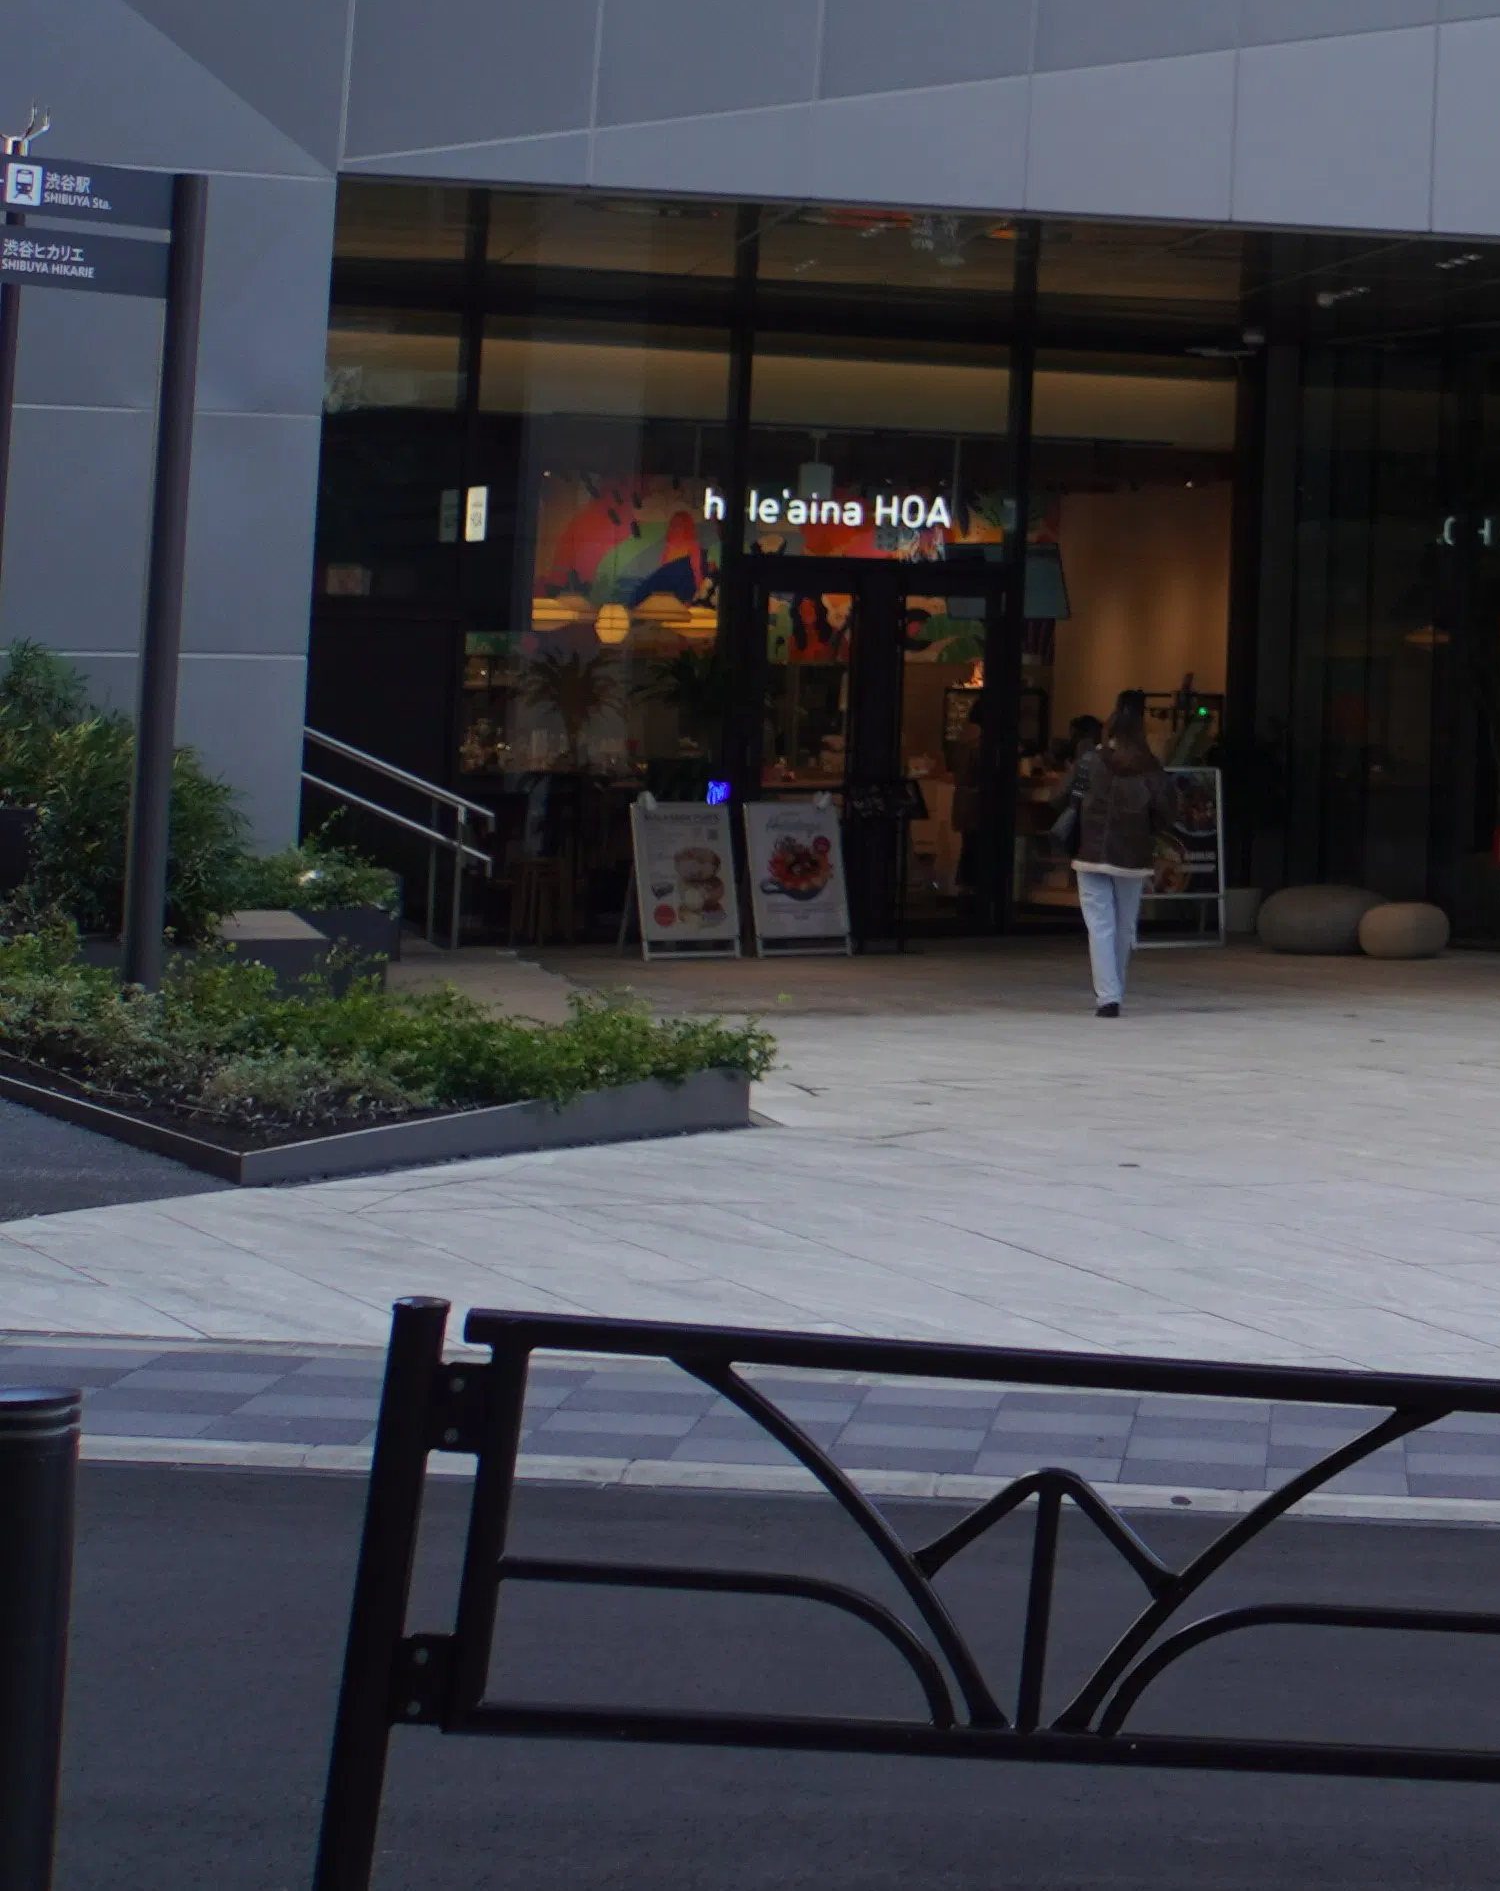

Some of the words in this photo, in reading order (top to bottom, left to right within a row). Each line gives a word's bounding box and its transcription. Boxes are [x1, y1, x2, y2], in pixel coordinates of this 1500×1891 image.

[45, 171, 91, 193] 渋谷駅
[43, 192, 90, 207] SHIBUYA
[92, 197, 112, 210] Sta.
[3, 237, 85, 262] 渋谷ヒカリエ
[0, 258, 49, 273] SHIBUYA
[51, 264, 95, 279] HIKARIE
[703, 487, 862, 527] hle'aina
[874, 494, 952, 529] HOA
